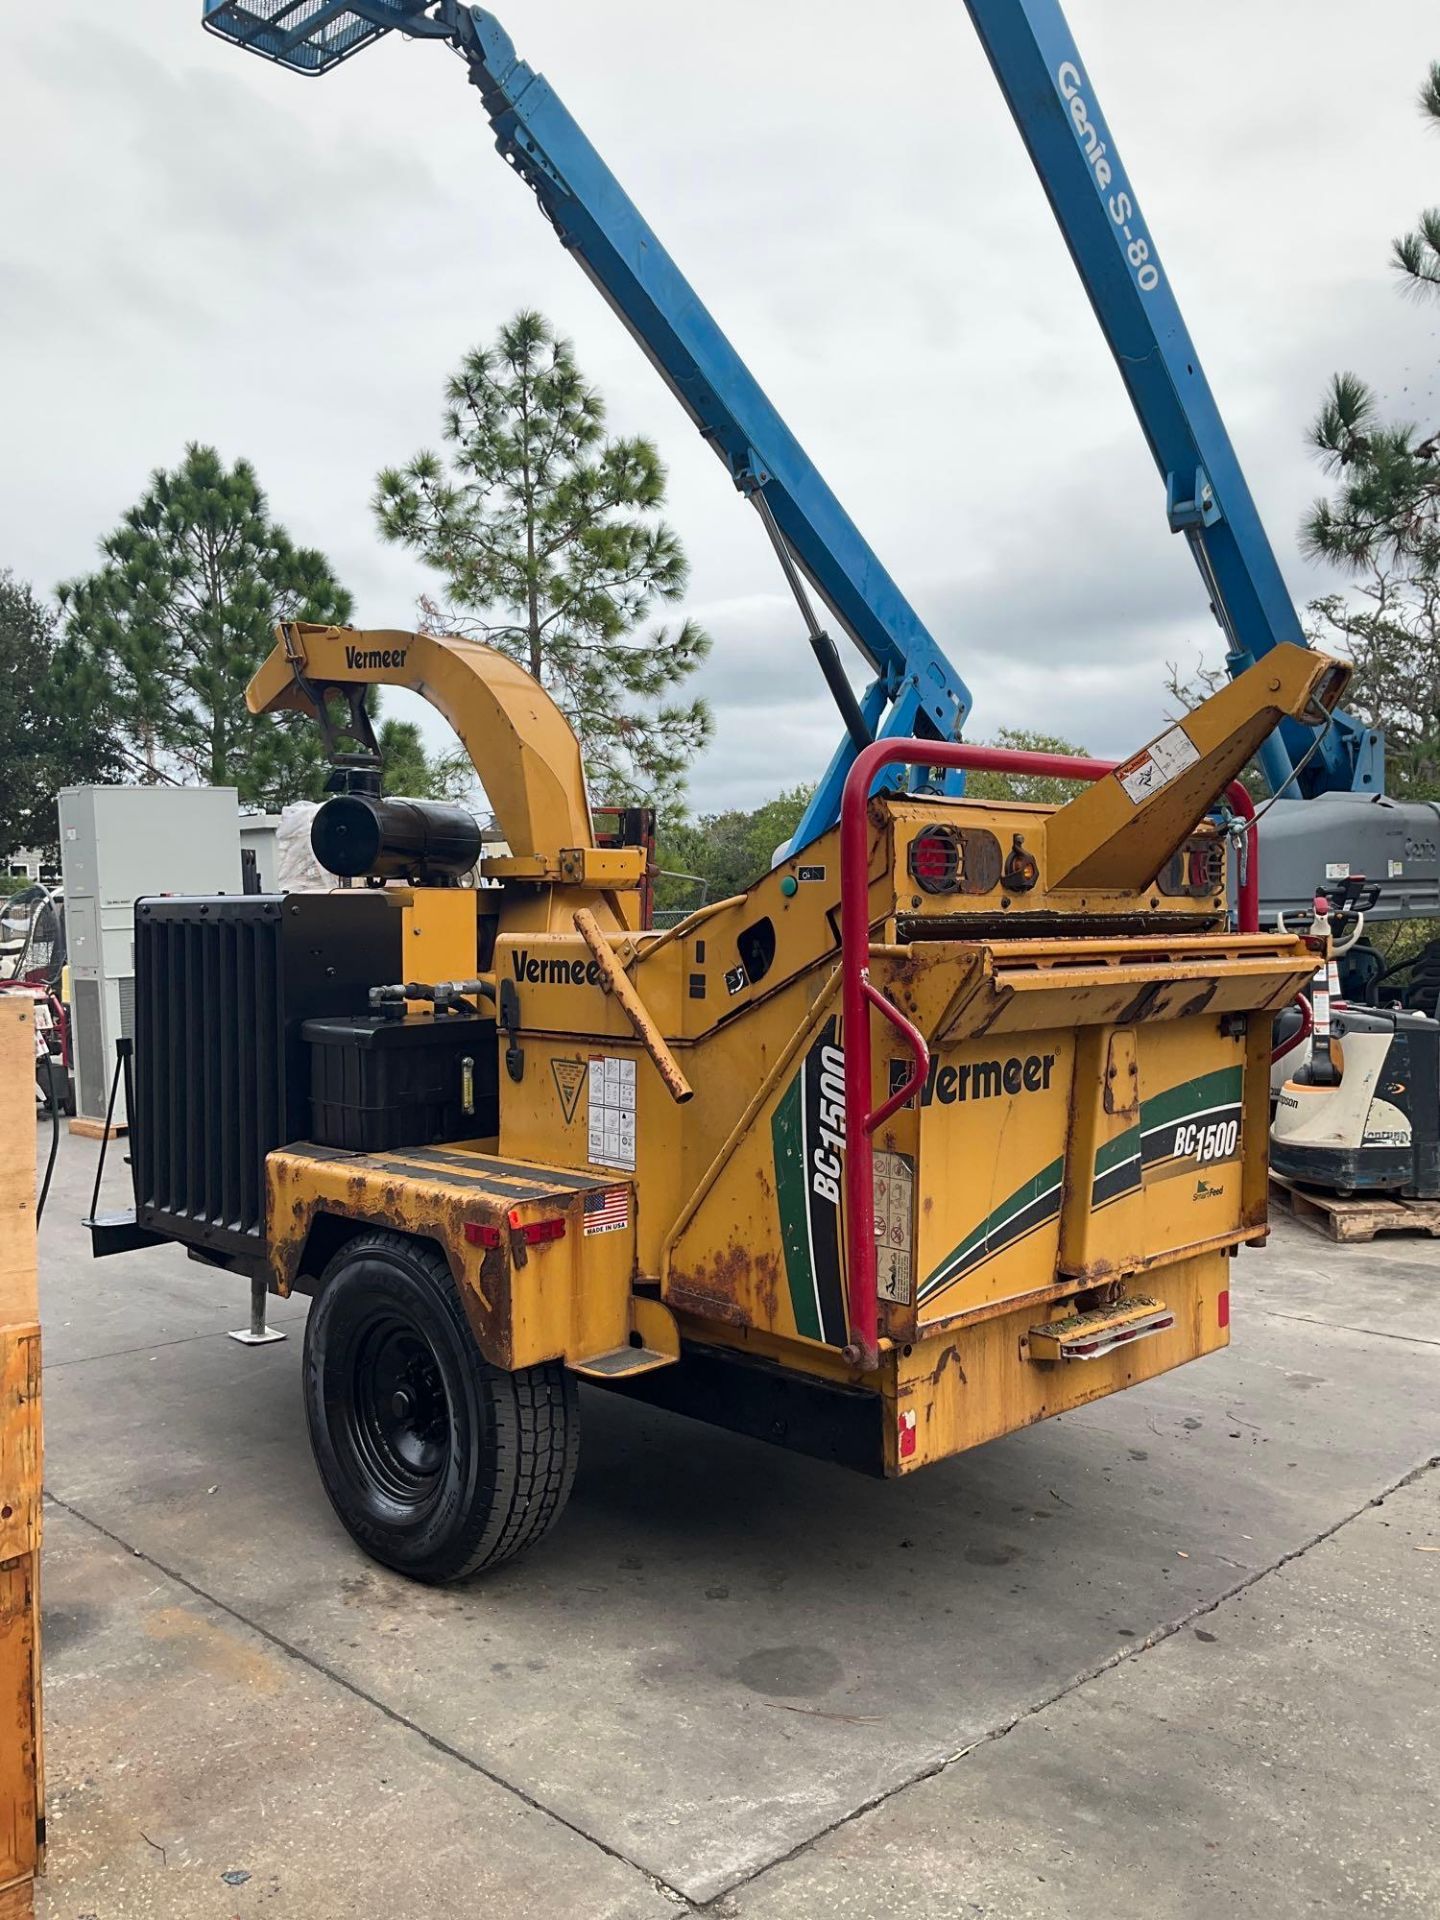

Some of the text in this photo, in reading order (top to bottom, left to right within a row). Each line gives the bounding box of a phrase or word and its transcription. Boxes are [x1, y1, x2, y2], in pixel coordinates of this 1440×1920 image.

[1058, 61, 1159, 291] Genie S-80
[345, 646, 406, 669] Vermeer
[511, 950, 602, 986] Vermee
[813, 1045, 847, 1205] BC1500
[1173, 1119, 1238, 1162] BC1500
[586, 1226, 604, 1235] MADE
[613, 1221, 626, 1230] USA
